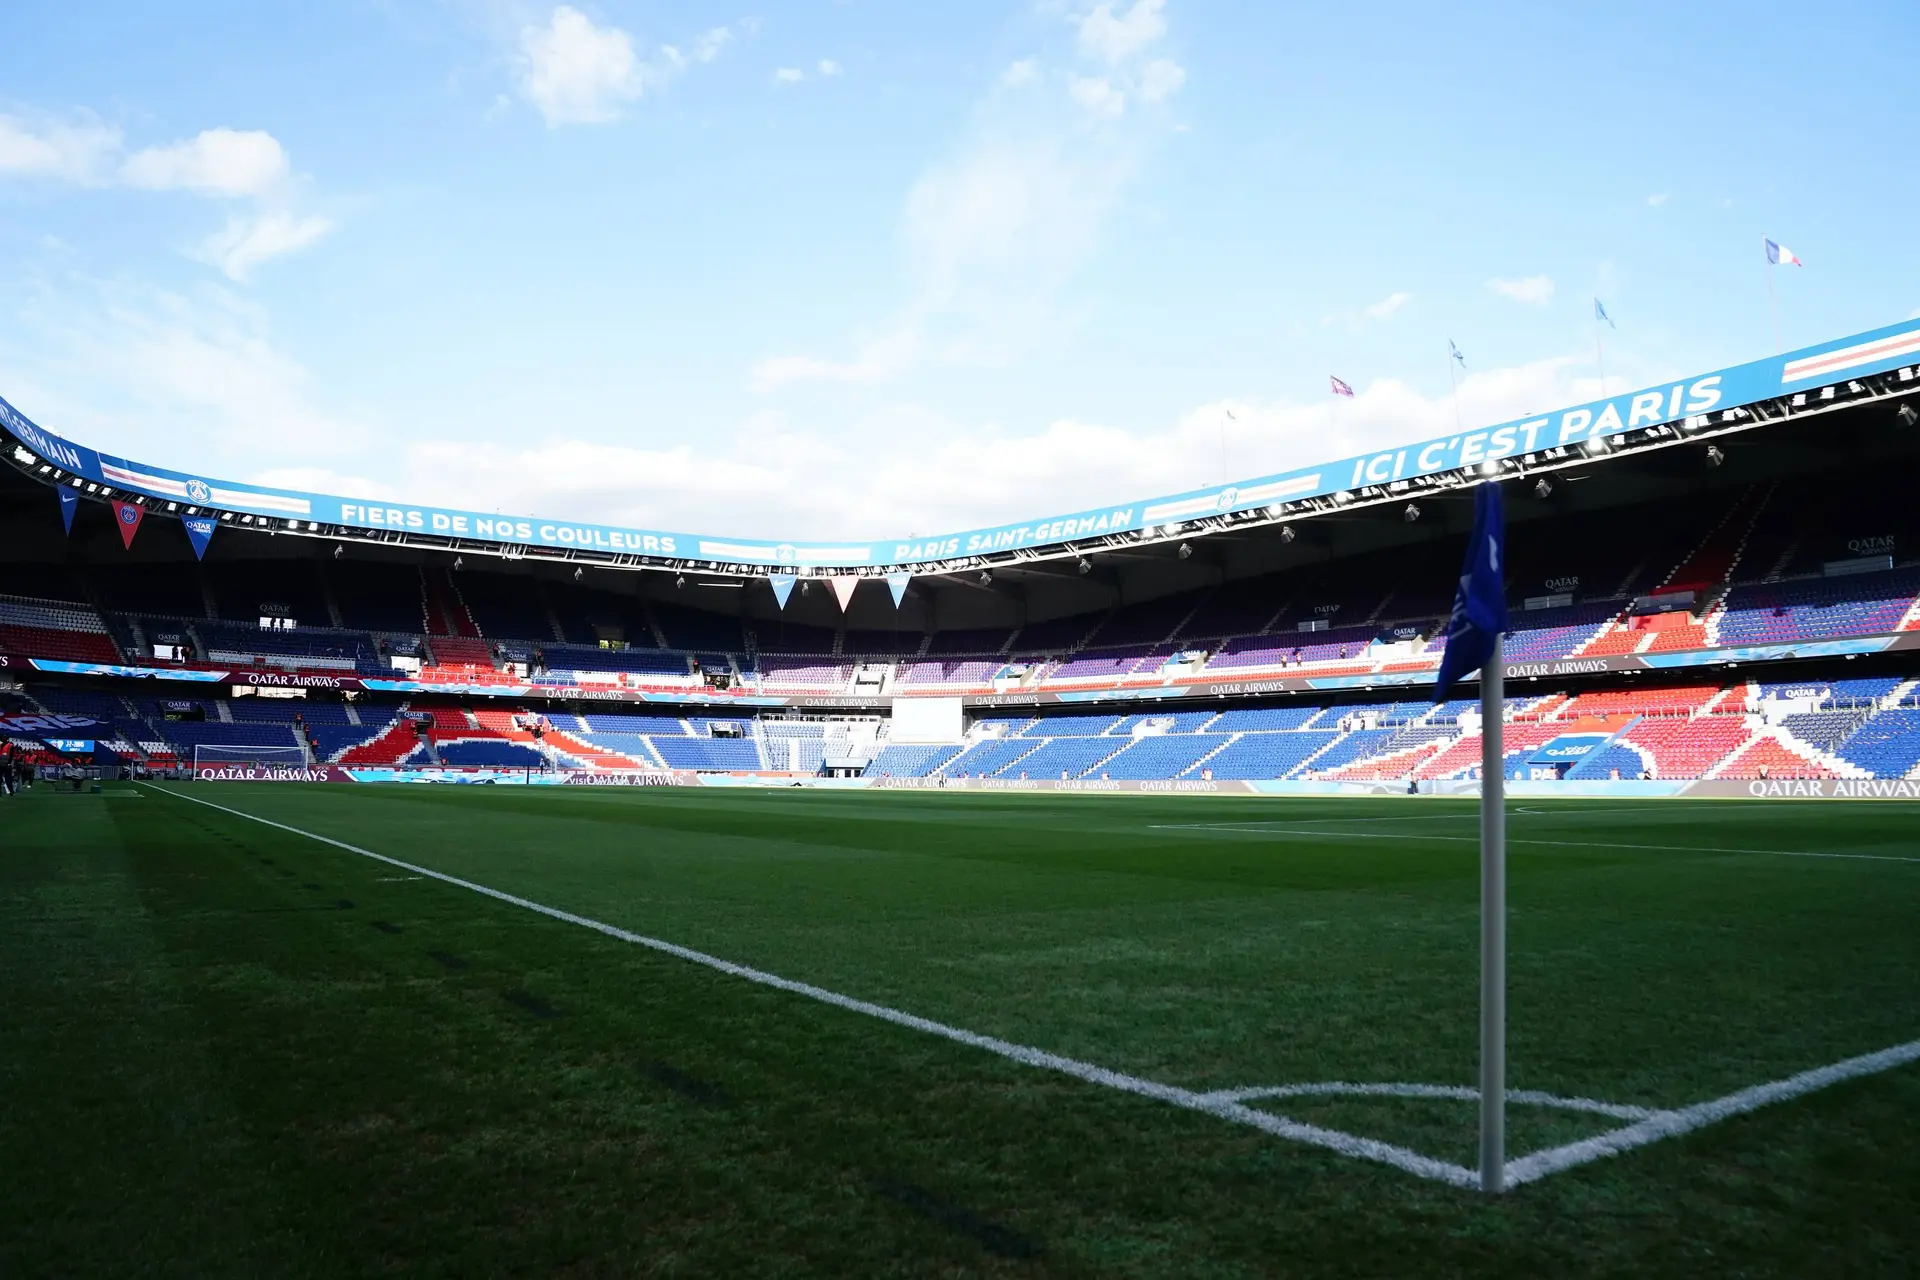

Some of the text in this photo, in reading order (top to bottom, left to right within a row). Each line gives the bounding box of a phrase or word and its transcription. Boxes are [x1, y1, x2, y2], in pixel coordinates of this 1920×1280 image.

[1351, 375, 1722, 487] ICI C'EST PARIS
[186, 521, 211, 530] QATAR
[341, 504, 677, 553] FIERS DE NOS COULEURS
[894, 508, 1133, 561] PARIS SAINT-GERMAIN
[1848, 534, 1894, 552] QATAR
[1545, 576, 1579, 590] QATAR
[260, 604, 290, 613] QATAR
[1314, 604, 1340, 613] QATAR
[1394, 627, 1416, 636] QATAR
[1506, 659, 1608, 677] QATAR AIRWAYS
[248, 674, 340, 688] QATAR AIRWAYS
[1210, 681, 1284, 695] QATAR AIRWAYS
[1785, 689, 1816, 698] QATAR
[546, 689, 623, 700] QATAR AIRWAYS
[805, 698, 879, 706] QATAR AIRWAYS
[975, 695, 1039, 706] QATAR AIRWAYS
[202, 768, 328, 781] QATAR AIRWAYS
[587, 775, 629, 785] QATAR
[633, 774, 685, 786] AIRWAYS
[885, 779, 918, 788] QATAR
[982, 780, 1038, 789] QATAR AIRWAYS
[1055, 781, 1120, 790] QATAR AIRWAYS
[1140, 781, 1218, 791] QATAR AIRWAYS
[1749, 780, 1824, 797] QATAR
